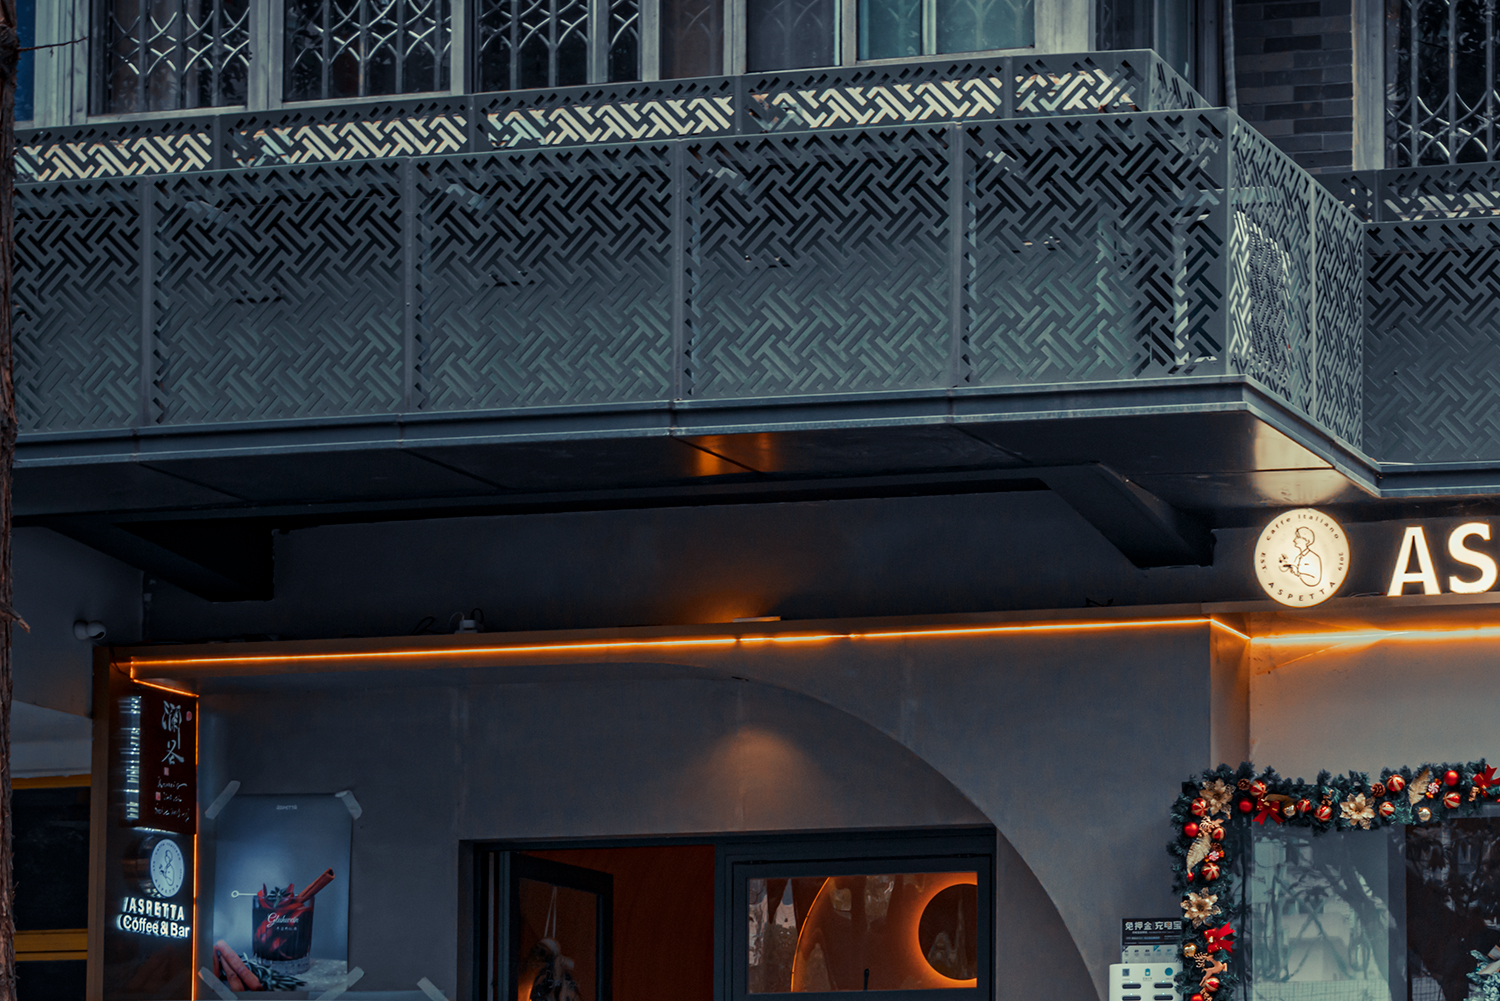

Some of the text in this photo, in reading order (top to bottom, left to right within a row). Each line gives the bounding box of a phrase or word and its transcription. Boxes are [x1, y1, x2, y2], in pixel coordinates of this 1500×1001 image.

[1268, 581, 1336, 602] ASPETTA
[128, 897, 185, 920] ASPETTA
[1125, 921, 1152, 931] 免押金
